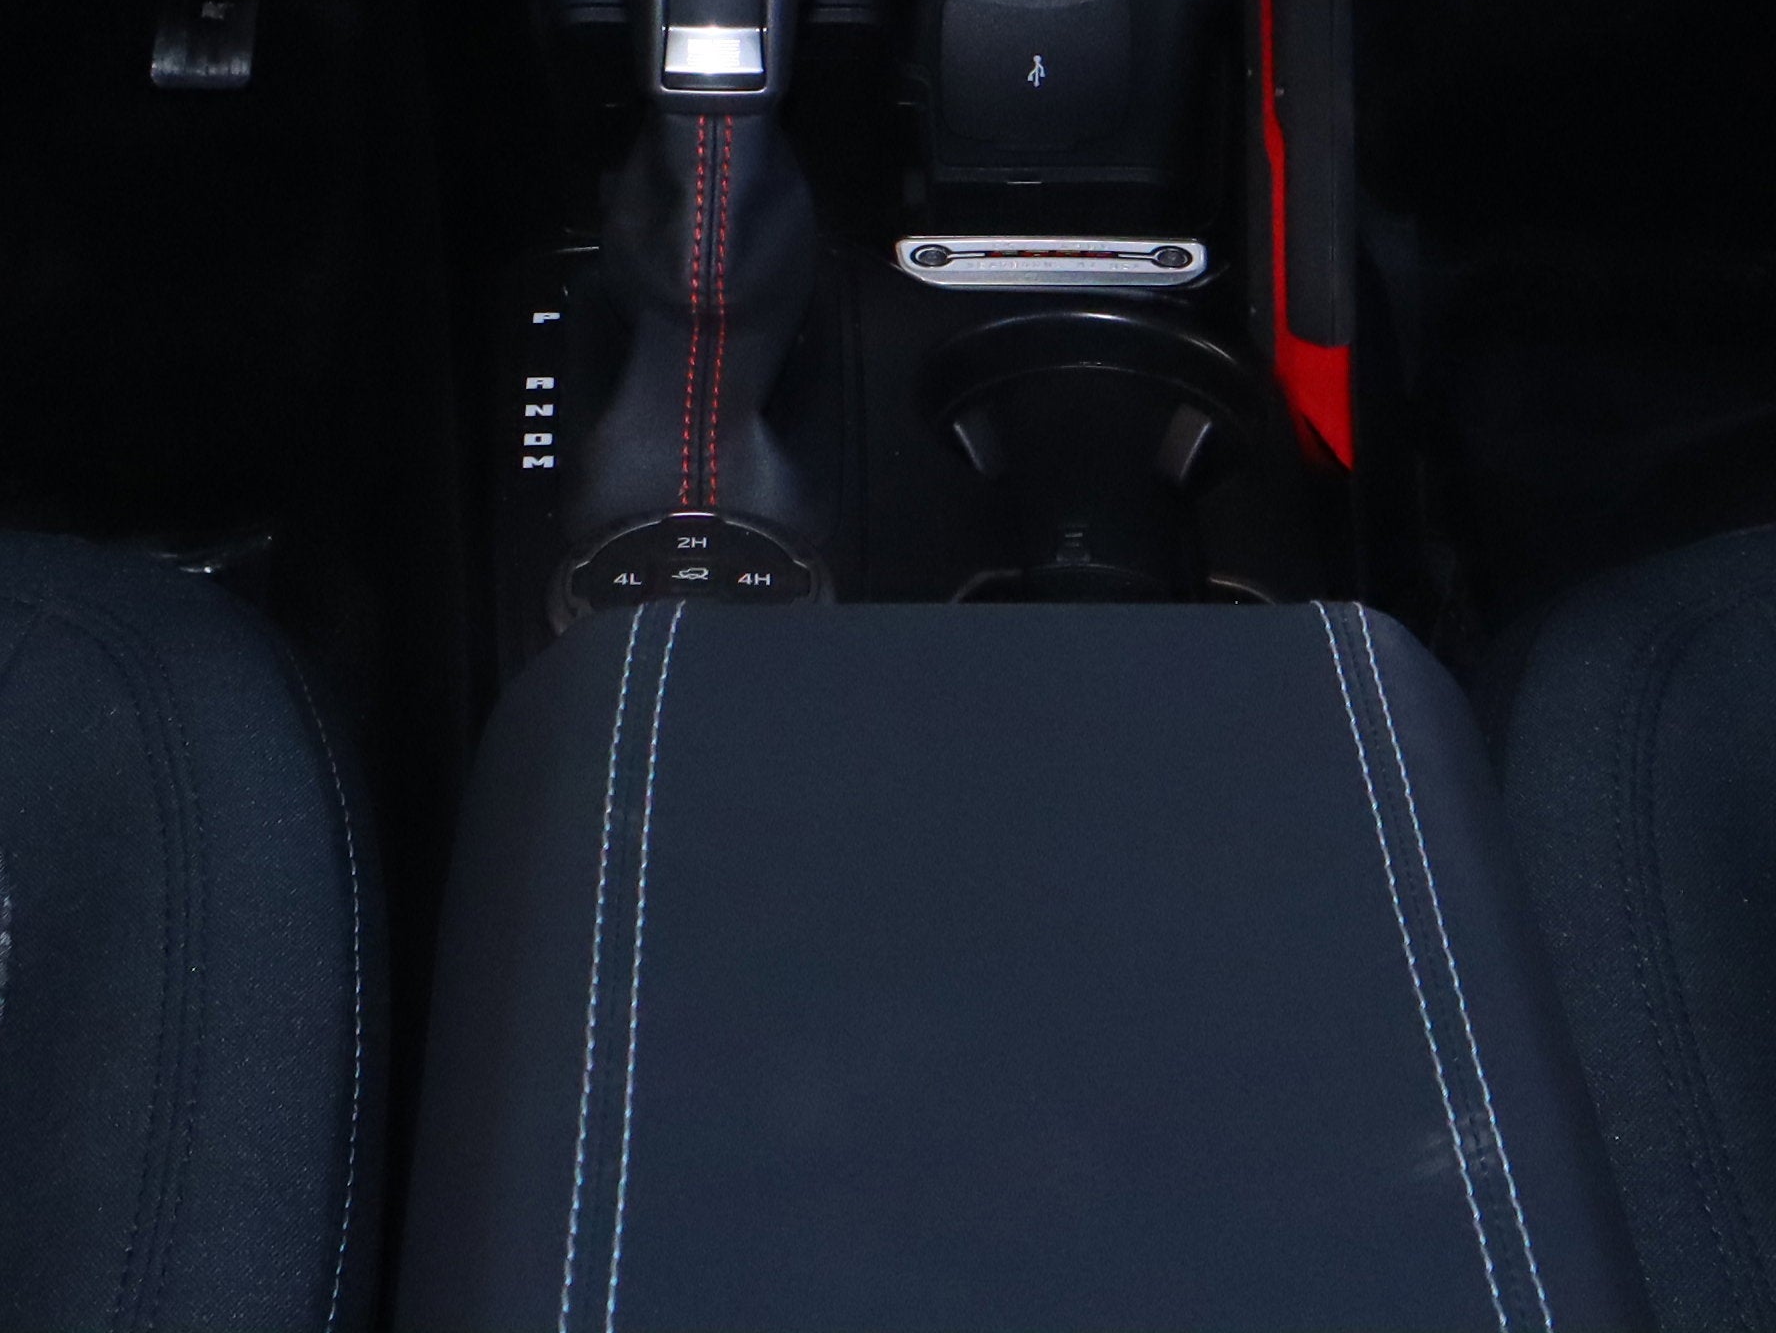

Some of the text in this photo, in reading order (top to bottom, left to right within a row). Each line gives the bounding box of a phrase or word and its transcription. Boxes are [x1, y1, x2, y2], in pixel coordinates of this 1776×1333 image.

[532, 311, 561, 324] P
[524, 403, 555, 417] N
[521, 455, 555, 469] M
[676, 536, 708, 549] 2H
[612, 572, 642, 587] 4L
[737, 572, 773, 587] 4H
